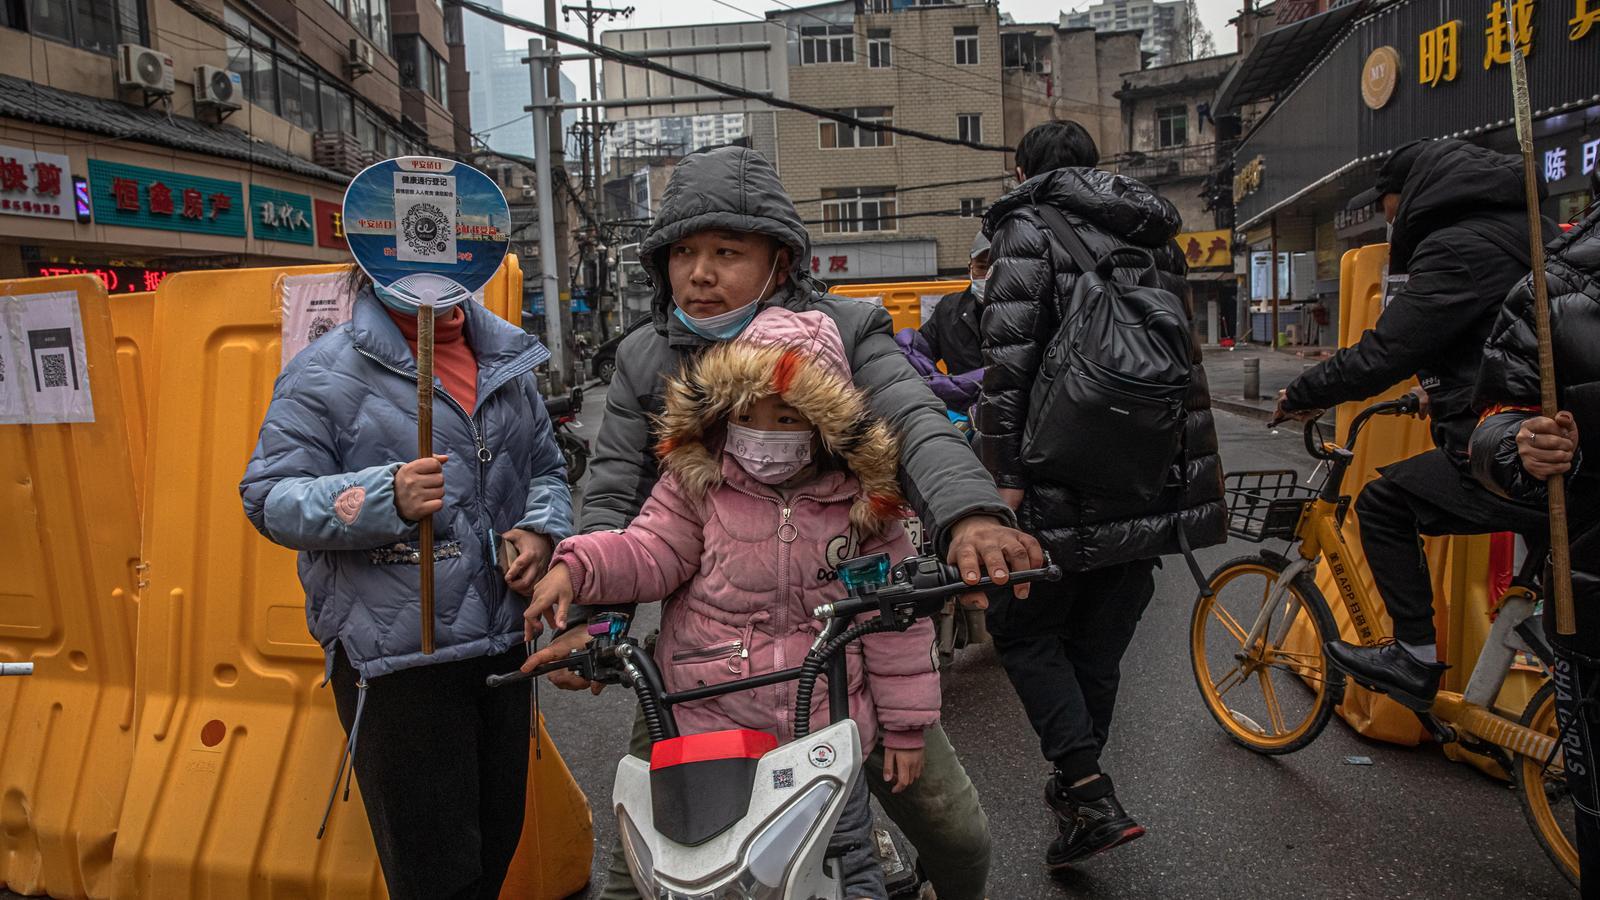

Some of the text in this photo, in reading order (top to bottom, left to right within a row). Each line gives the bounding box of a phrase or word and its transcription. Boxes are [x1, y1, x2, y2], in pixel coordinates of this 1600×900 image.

[1370, 65, 1386, 81] MY
[402, 176, 448, 187] 健康通行登记
[112, 177, 232, 219] 恒鑫房产
[261, 201, 311, 232] 现代人
